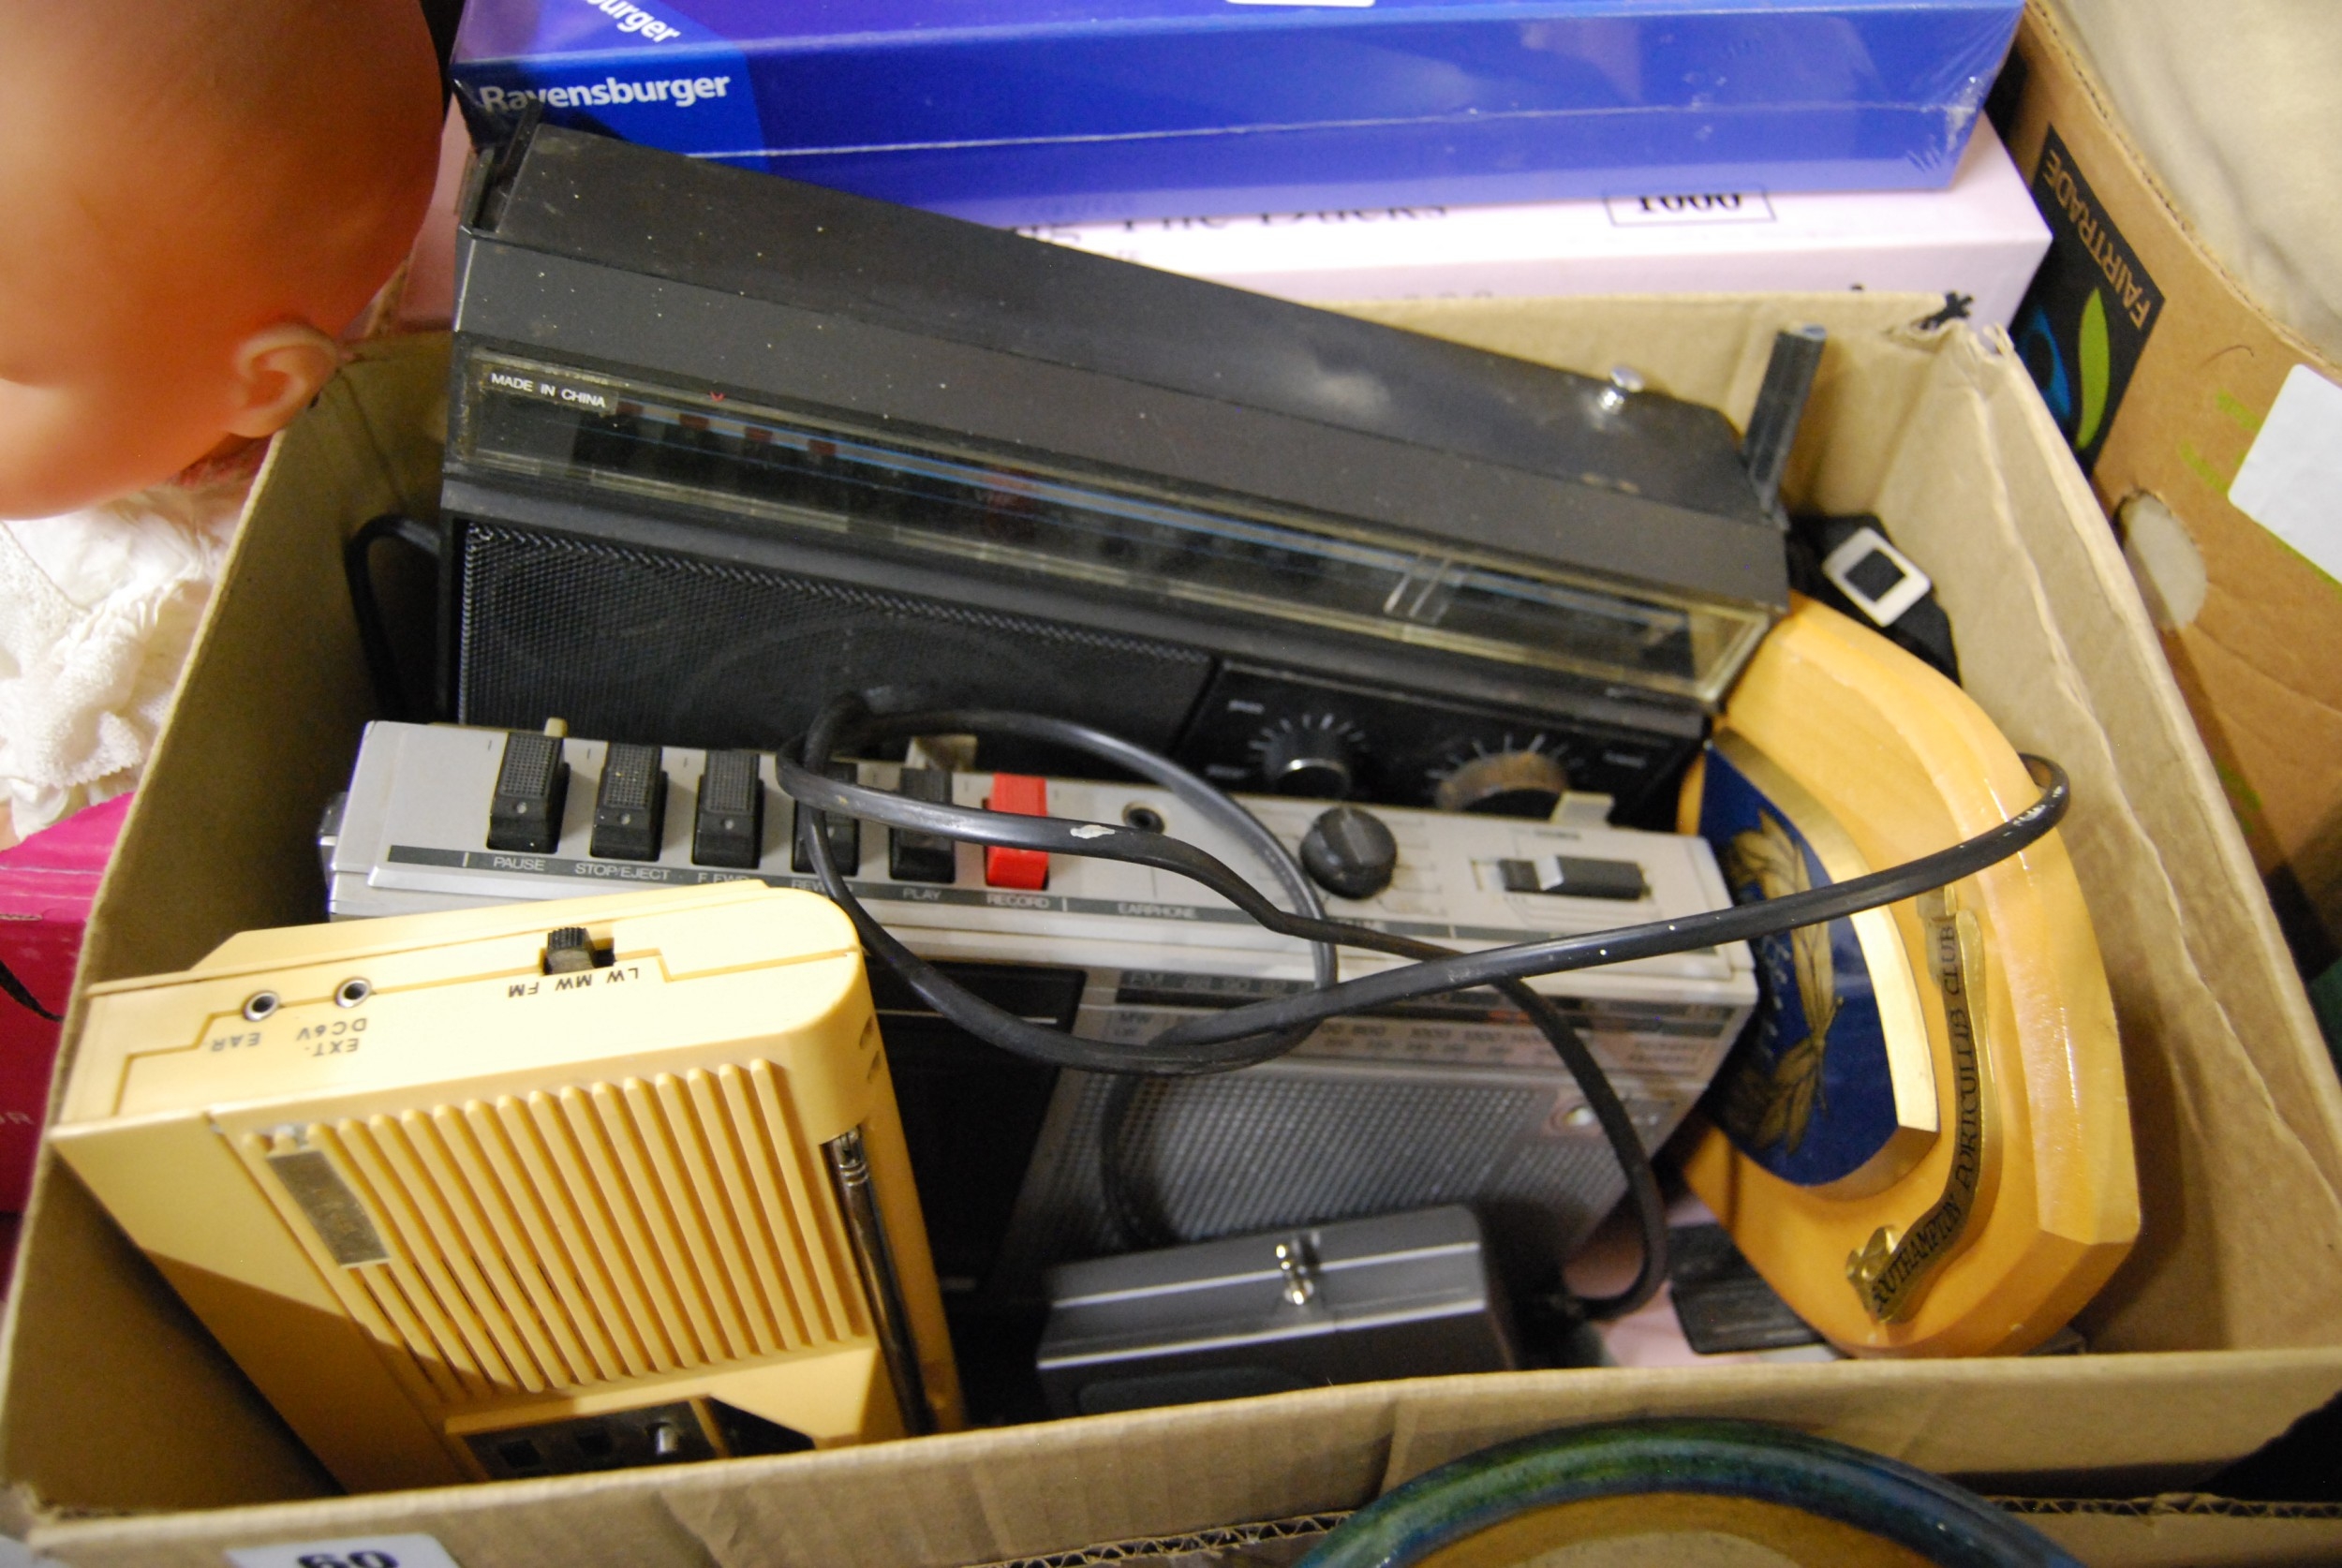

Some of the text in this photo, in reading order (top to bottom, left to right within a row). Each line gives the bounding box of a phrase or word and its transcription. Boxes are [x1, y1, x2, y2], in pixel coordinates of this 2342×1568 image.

[586, 0, 681, 43] urger
[479, 76, 731, 113] Ravensburger
[2042, 149, 2152, 330] FAIRTRADE
[491, 373, 606, 408] MADE IN CHINA
[493, 856, 546, 871] PAUSE
[574, 863, 672, 880] STOP/EJECT
[902, 888, 941, 901] PLAY
[986, 893, 1051, 910] RECORD
[1118, 902, 1198, 920] EARPHONE
[1940, 925, 1961, 996] CLUB
[508, 967, 639, 998] LW MW FM
[211, 1031, 261, 1052] EAR
